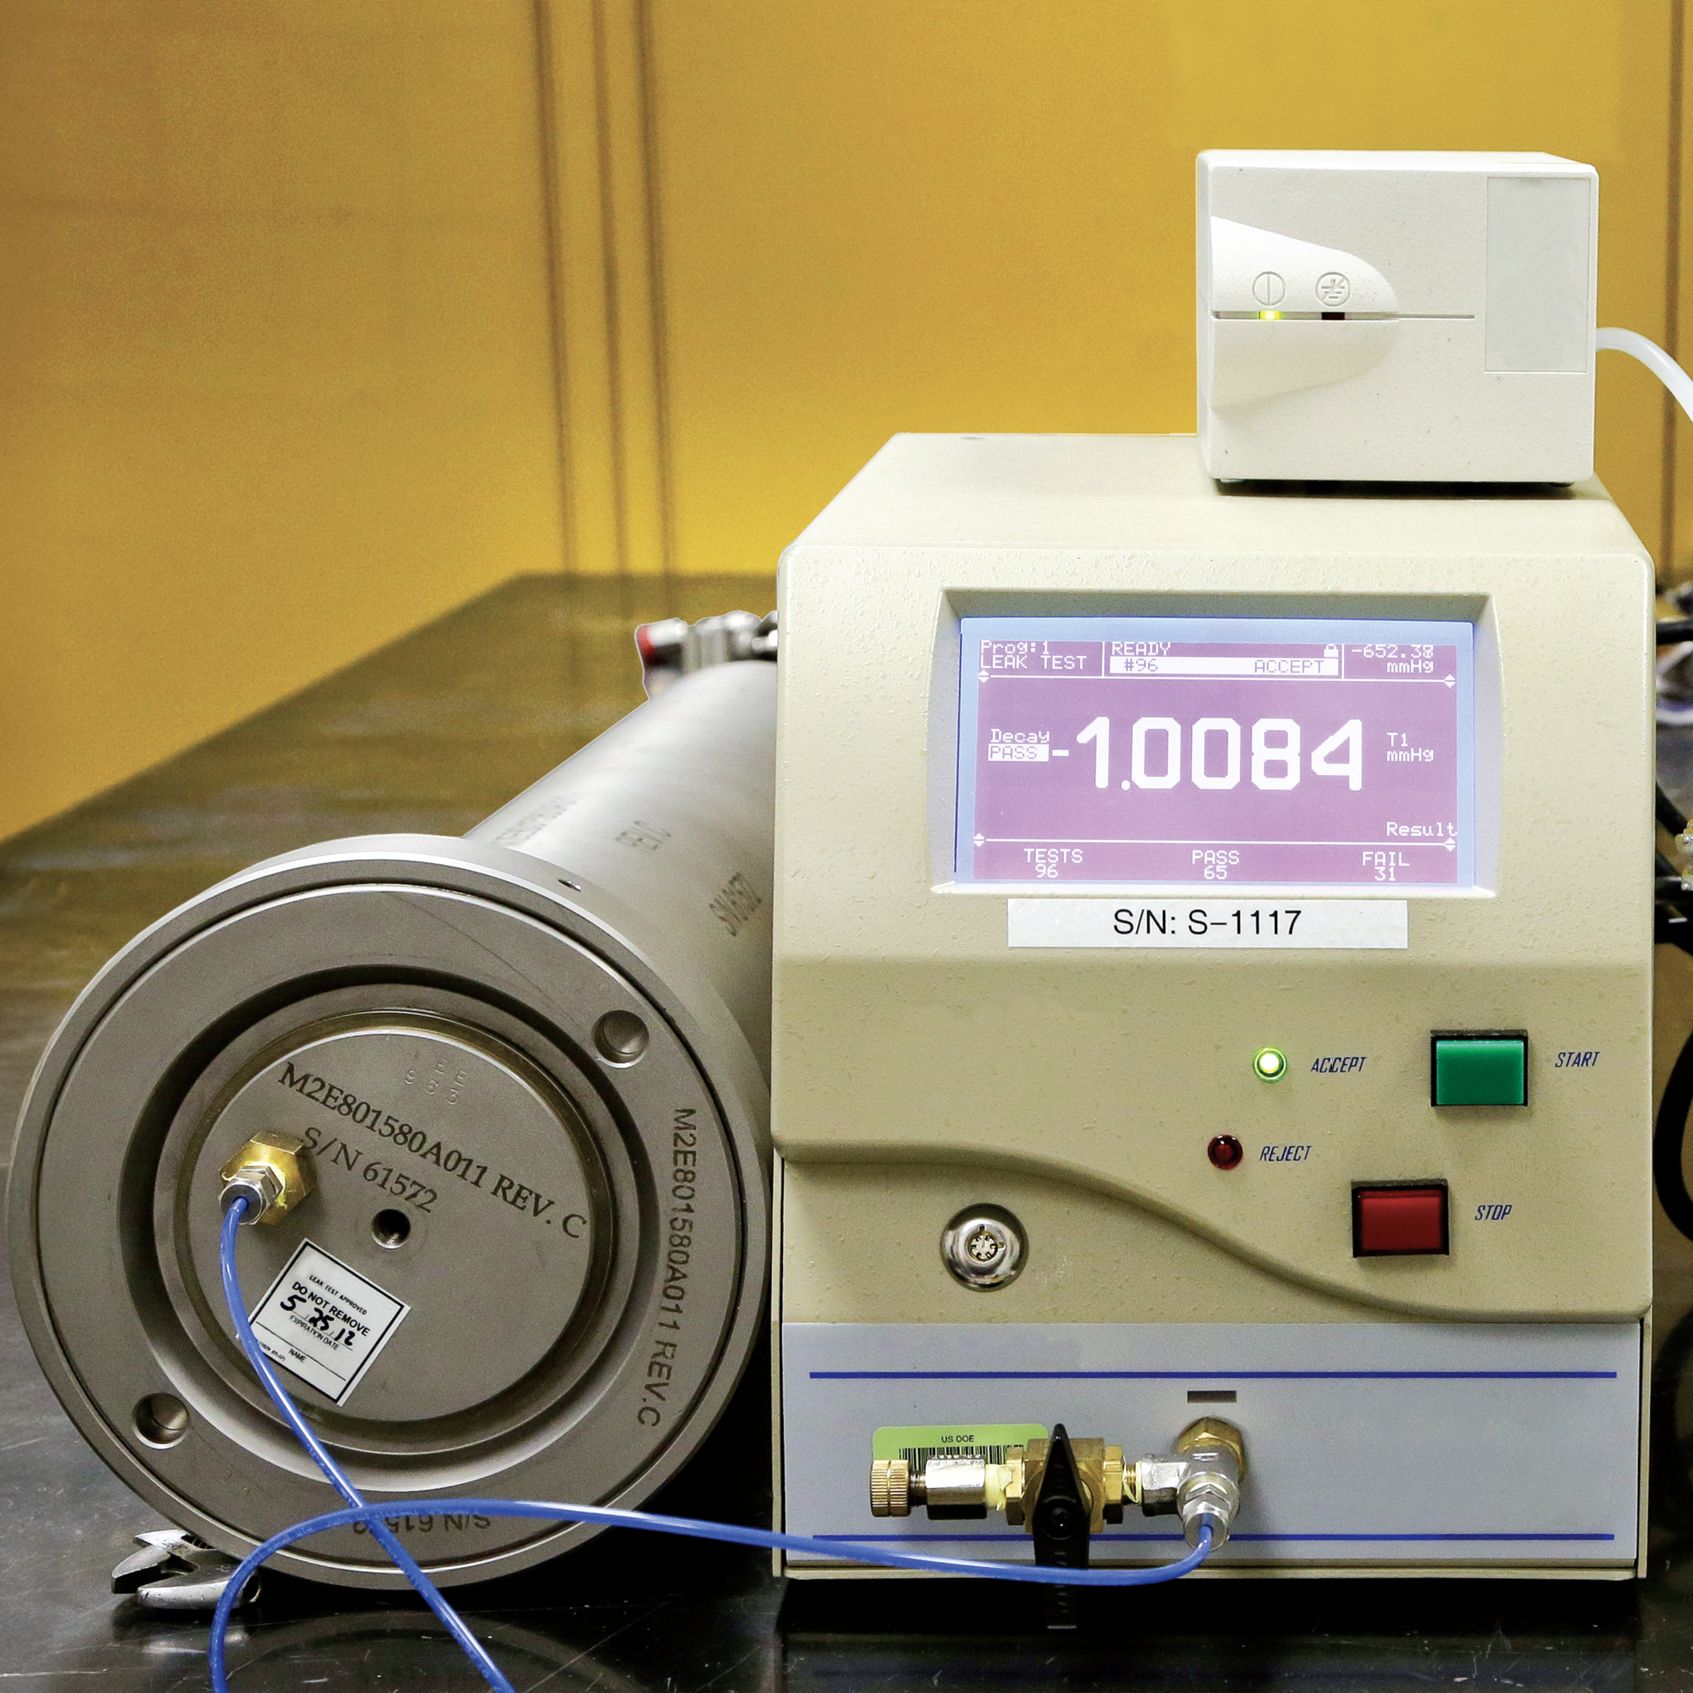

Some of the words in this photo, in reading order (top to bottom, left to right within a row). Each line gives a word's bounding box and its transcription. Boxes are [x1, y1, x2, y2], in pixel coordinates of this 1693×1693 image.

[1111, 641, 1171, 656] READY
[980, 655, 1028, 670] LEAK
[1041, 655, 1087, 670] TEST
[1124, 658, 1159, 672] #96
[1254, 659, 1325, 674] ACCEPT
[1386, 660, 1435, 674] mmHg
[990, 728, 1050, 743] Decay
[1386, 732, 1409, 747] T1
[989, 745, 1038, 760] PASS
[1051, 716, 1363, 791] -1.0084
[1386, 748, 1435, 762] mmHg
[1386, 821, 1458, 837] Result
[1023, 848, 1083, 864] TESTS
[1191, 850, 1240, 865] PASS
[1362, 852, 1410, 867] FAIL
[1035, 863, 1059, 878] 96
[1204, 865, 1228, 880] 65
[1375, 867, 1397, 881] 31
[1113, 908, 1176, 936] S/N:
[1188, 908, 1302, 936] S-1117
[1310, 1056, 1367, 1073] ACCEPT
[1554, 1051, 1600, 1068] START
[277, 1061, 489, 1188] M2E801580A011
[490, 1174, 555, 1226] REV.
[561, 1213, 588, 1238] C
[1259, 1145, 1312, 1162] REJECT
[300, 1125, 363, 1172] S/N
[363, 1161, 439, 1214] 61572
[659, 1107, 697, 1332] M2E801580A011
[1474, 1204, 1513, 1221] STOP
[309, 1275, 324, 1287] LEAK
[325, 1284, 338, 1296] TEST
[339, 1293, 367, 1315] APPROVED
[280, 1295, 306, 1311] 5
[292, 1282, 307, 1295] DO
[307, 1291, 330, 1310] NOT
[328, 1305, 371, 1337] REMOVE
[289, 1314, 325, 1341] EXPIRATION
[323, 1337, 340, 1350] DATE
[289, 1349, 306, 1362] NAME
[941, 1435, 954, 1444] US
[955, 1434, 975, 1443] DOE
